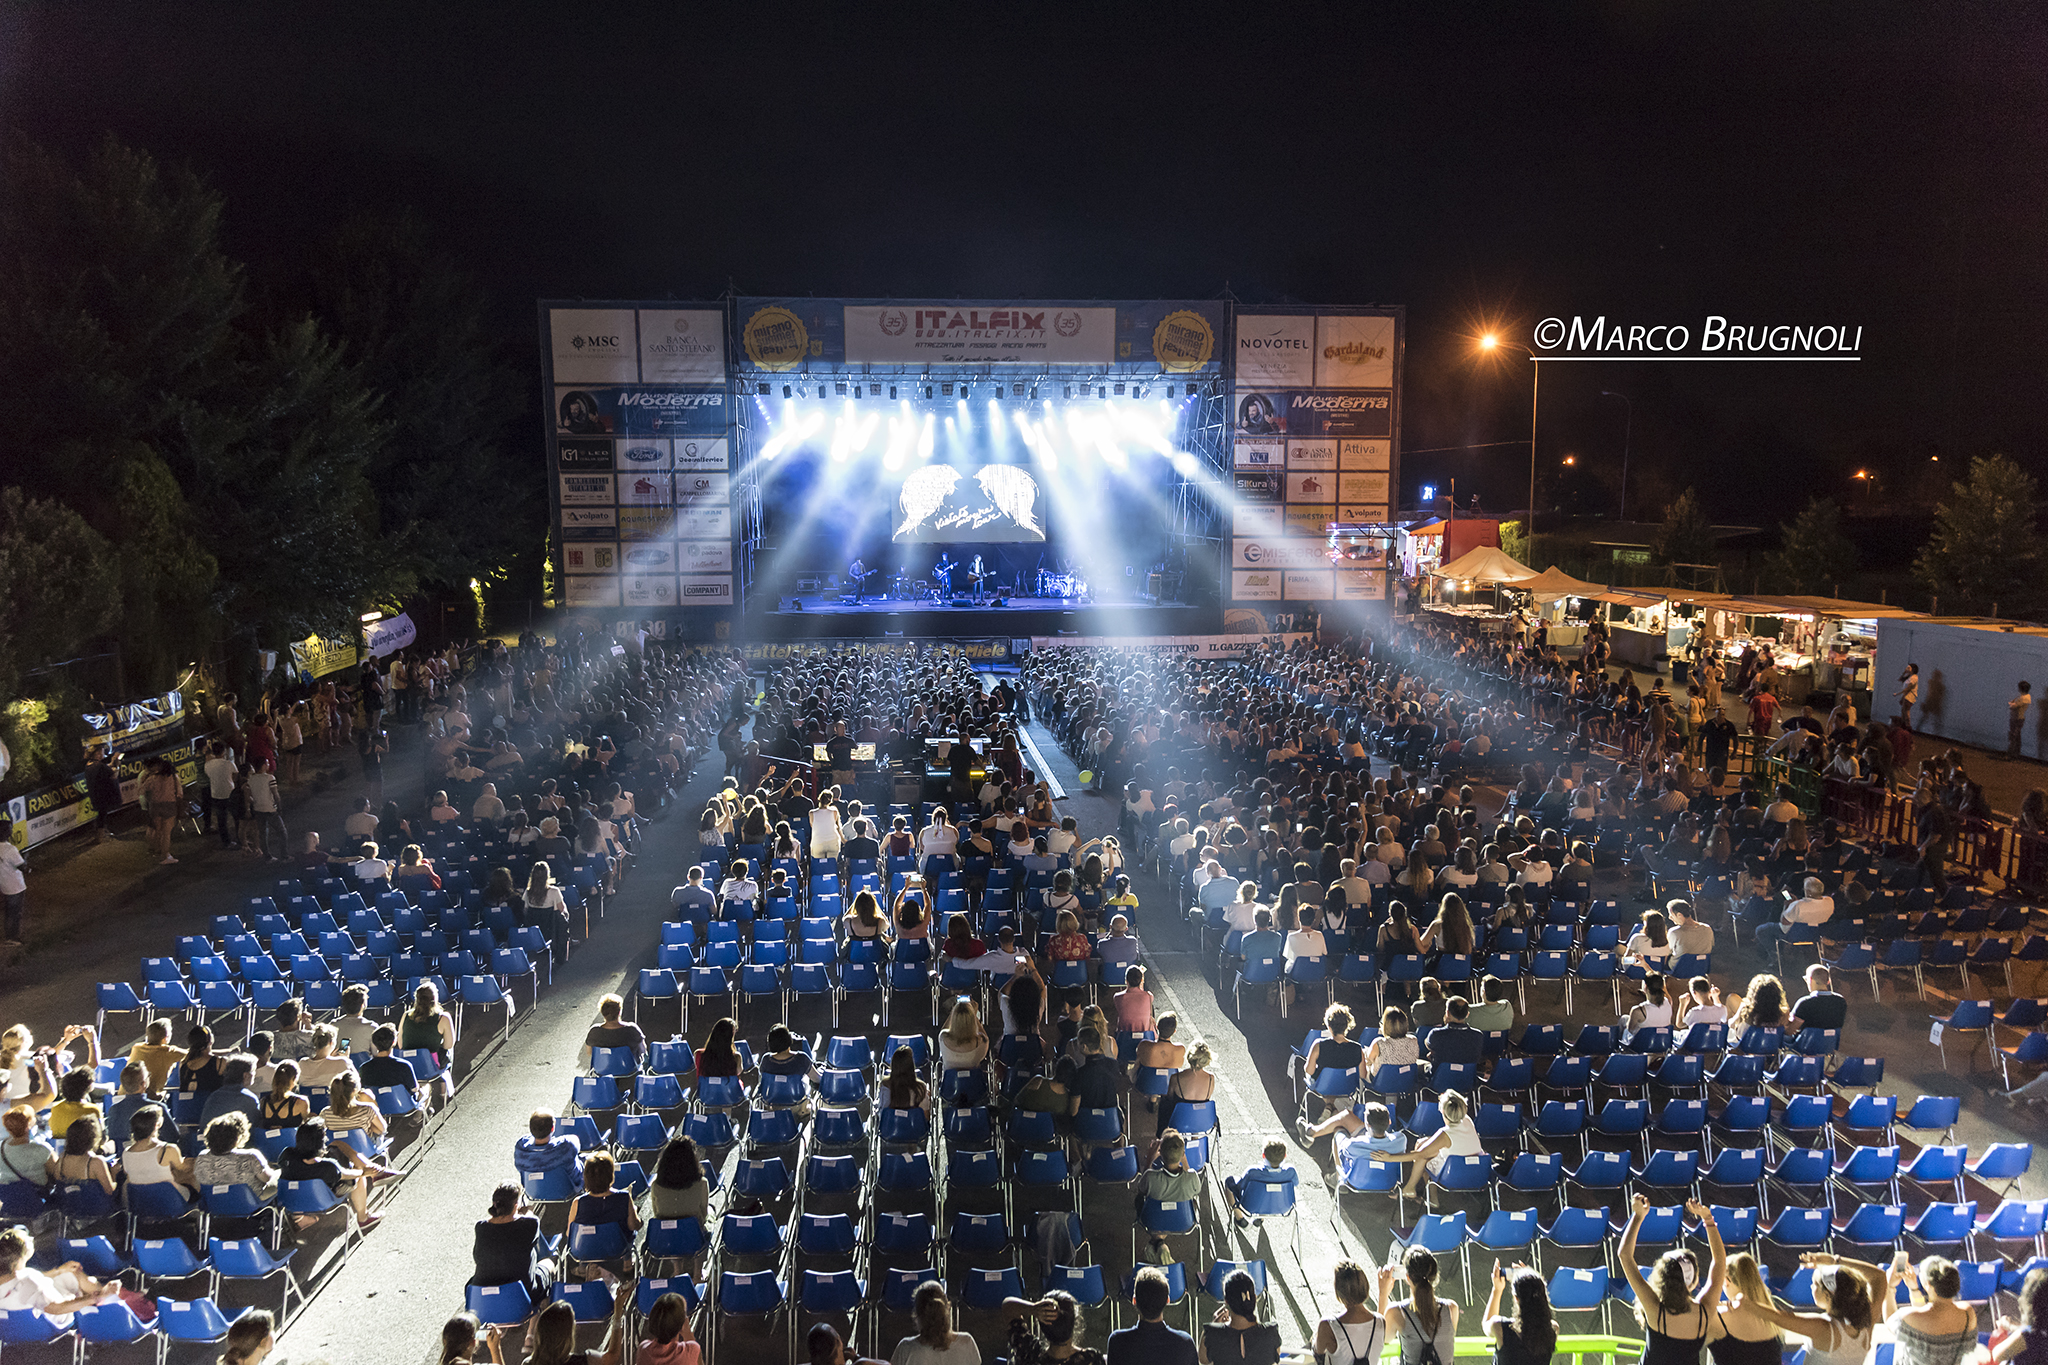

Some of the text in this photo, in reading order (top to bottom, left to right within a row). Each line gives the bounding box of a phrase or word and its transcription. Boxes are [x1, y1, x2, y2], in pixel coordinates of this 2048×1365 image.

[886, 317, 901, 327] 35
[916, 310, 1046, 330] ITALFIX
[1060, 318, 1075, 328] 35
[753, 320, 792, 339] mirano
[915, 330, 1046, 338] WWW.ITALFIX.IT
[1167, 323, 1204, 341] mirano
[588, 336, 619, 347] MSC
[666, 336, 698, 344] BANCA
[1241, 339, 1309, 349] NOVOTEL
[679, 345, 716, 353] STEFANO
[1324, 341, 1384, 360] Gardaland
[618, 393, 722, 406] Moderna
[1292, 396, 1388, 408] Moderna
[1344, 444, 1375, 454] Attiva
[631, 450, 655, 459] Ford
[695, 479, 709, 488] CM
[579, 512, 609, 520] volpato
[1354, 509, 1382, 517] volpato
[1123, 645, 1199, 653] IL GAZZETTINO
[160, 746, 192, 763] ENEZIA
[28, 791, 60, 813] RADIO
